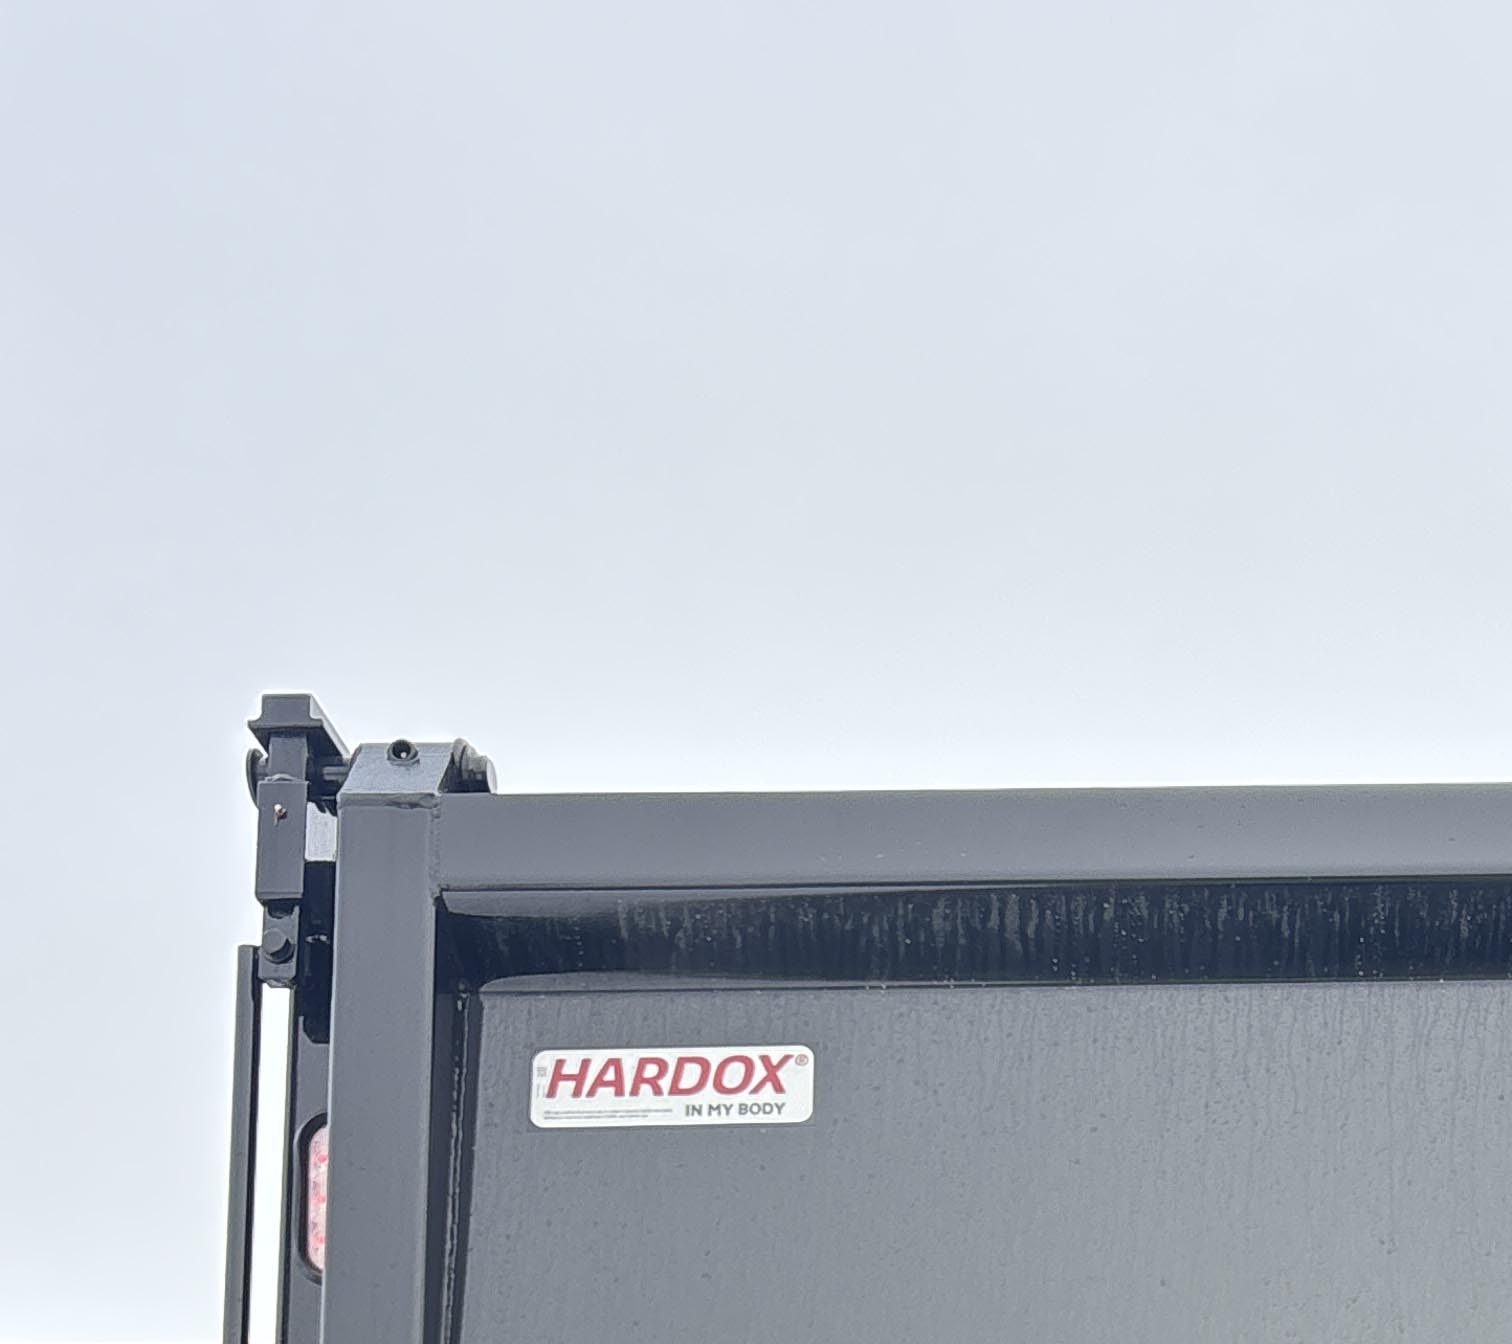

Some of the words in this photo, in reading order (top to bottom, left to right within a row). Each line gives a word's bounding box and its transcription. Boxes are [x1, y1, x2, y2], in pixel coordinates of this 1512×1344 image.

[685, 1104, 703, 1117] IN
[707, 1103, 734, 1117] MY
[738, 1102, 786, 1116] BODY
